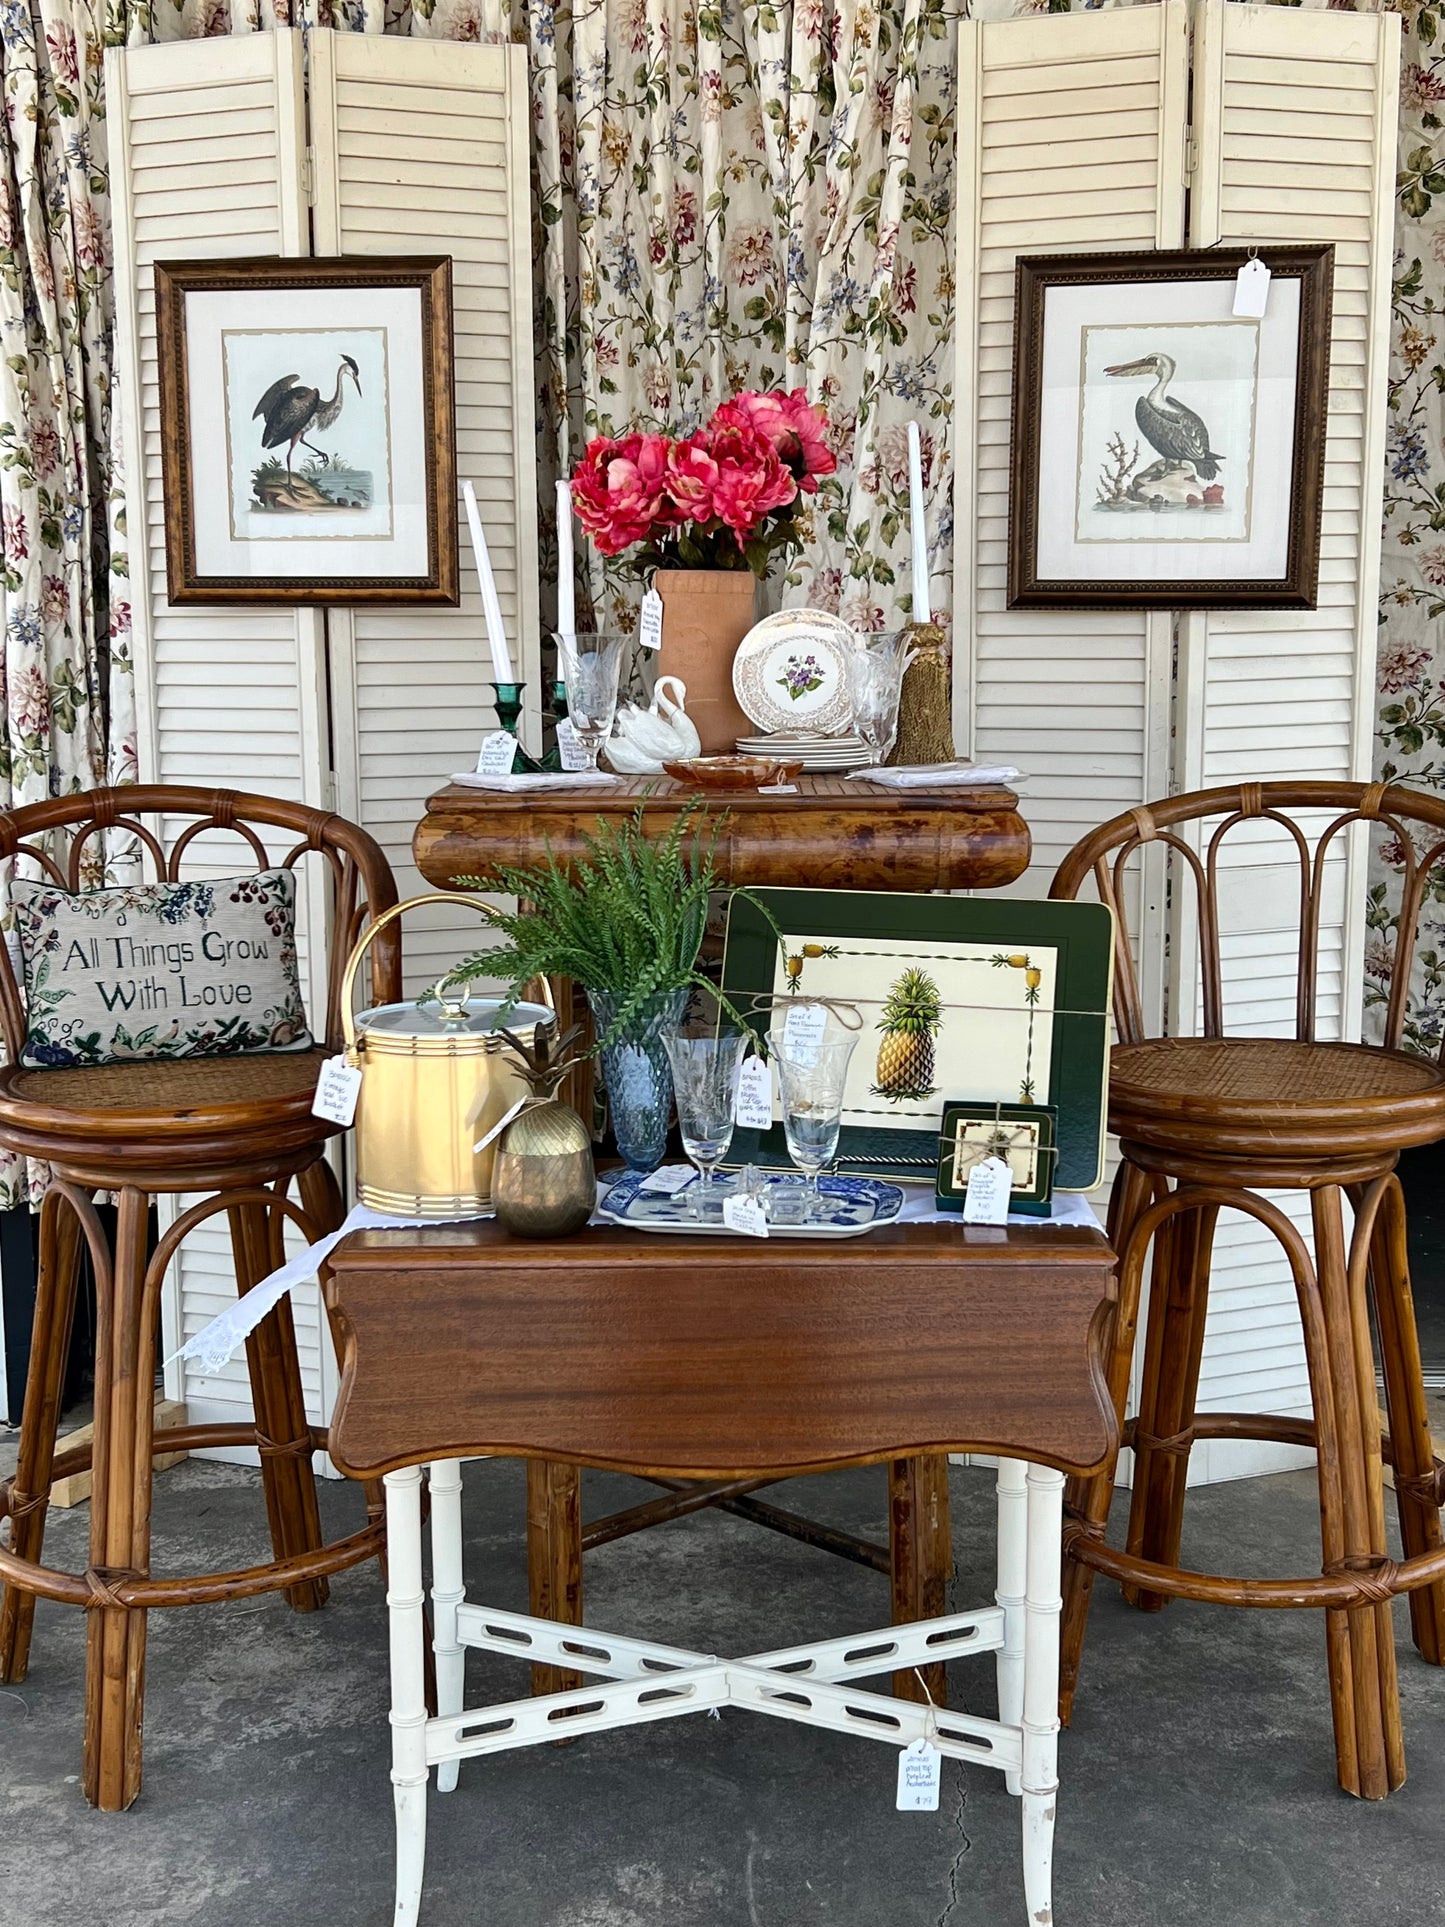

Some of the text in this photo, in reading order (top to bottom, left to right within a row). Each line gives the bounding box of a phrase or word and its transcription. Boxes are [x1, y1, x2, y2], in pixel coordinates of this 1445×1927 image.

[61, 931, 269, 974] All Things Grow
[95, 975, 253, 1012] With Love
